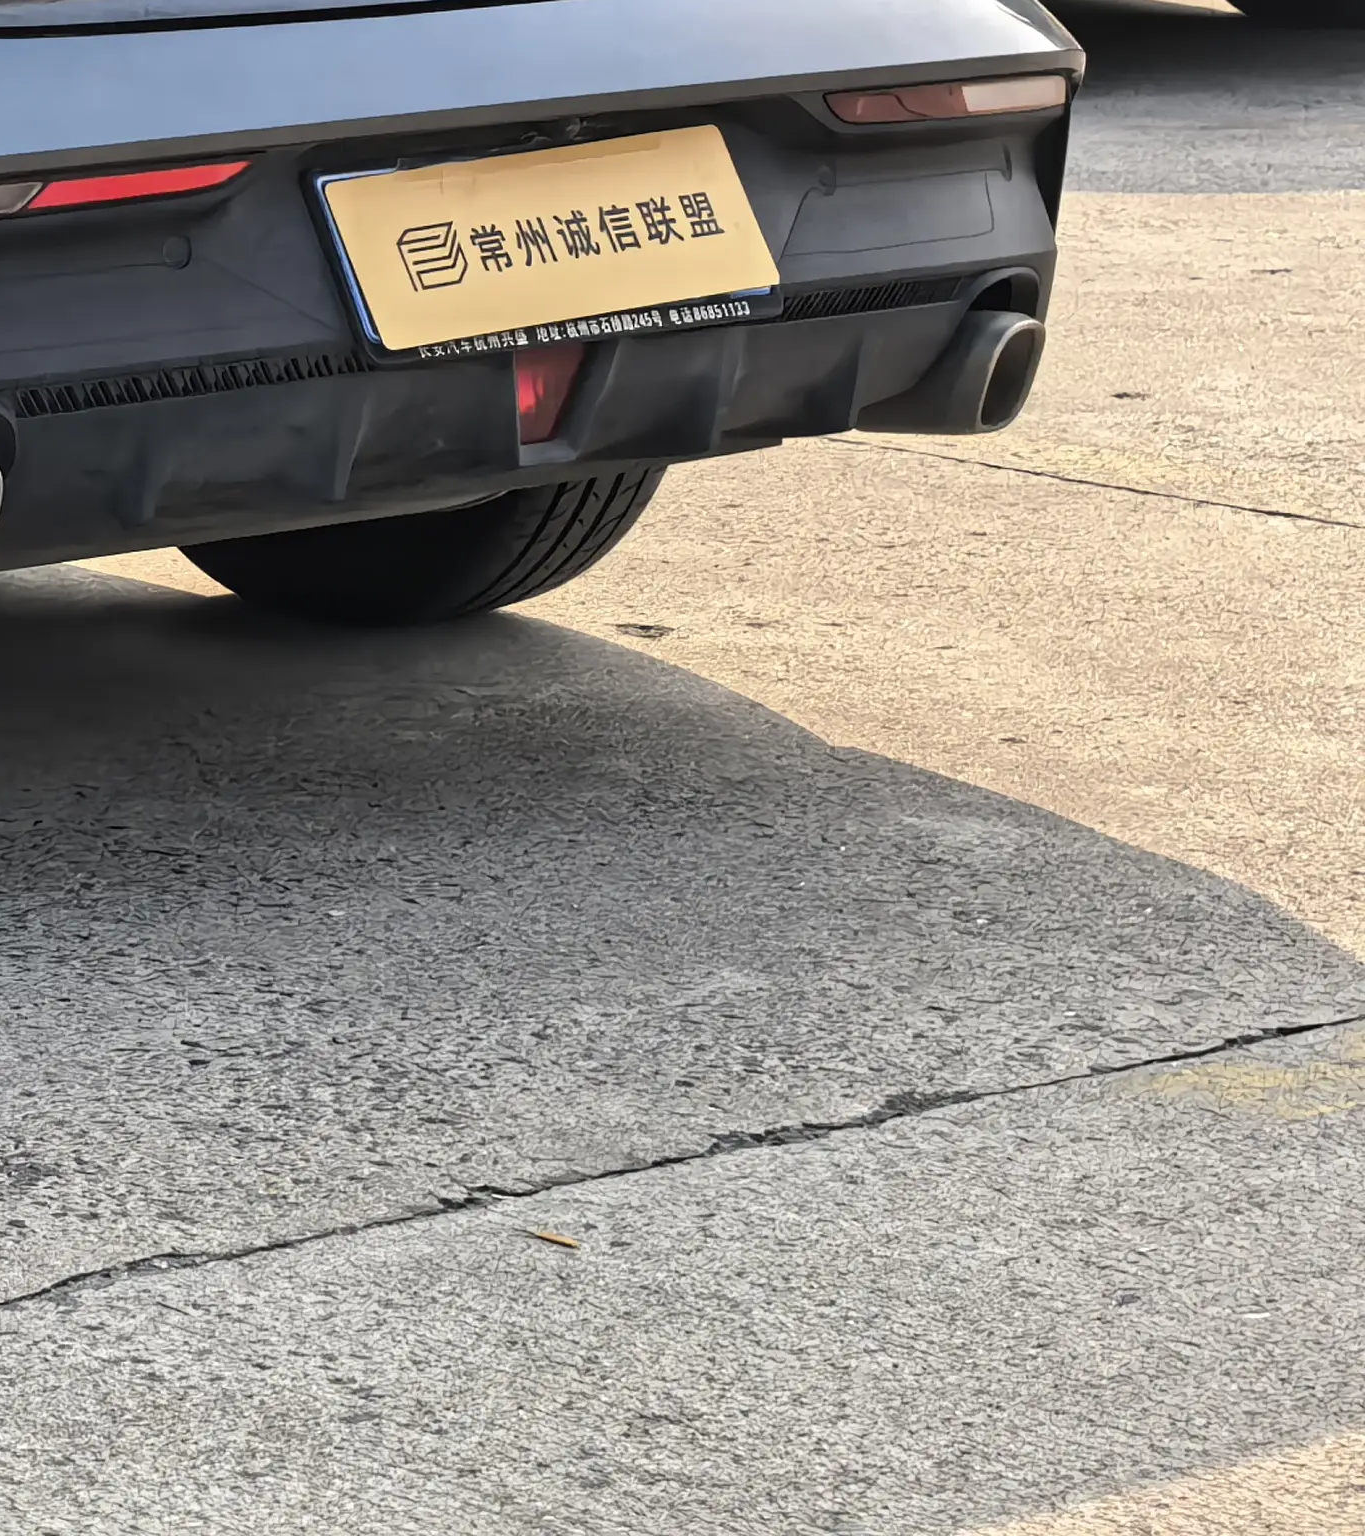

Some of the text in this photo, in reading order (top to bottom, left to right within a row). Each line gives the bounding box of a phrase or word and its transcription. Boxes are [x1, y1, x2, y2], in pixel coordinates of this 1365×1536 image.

[469, 191, 725, 273] 常州诚信联盟
